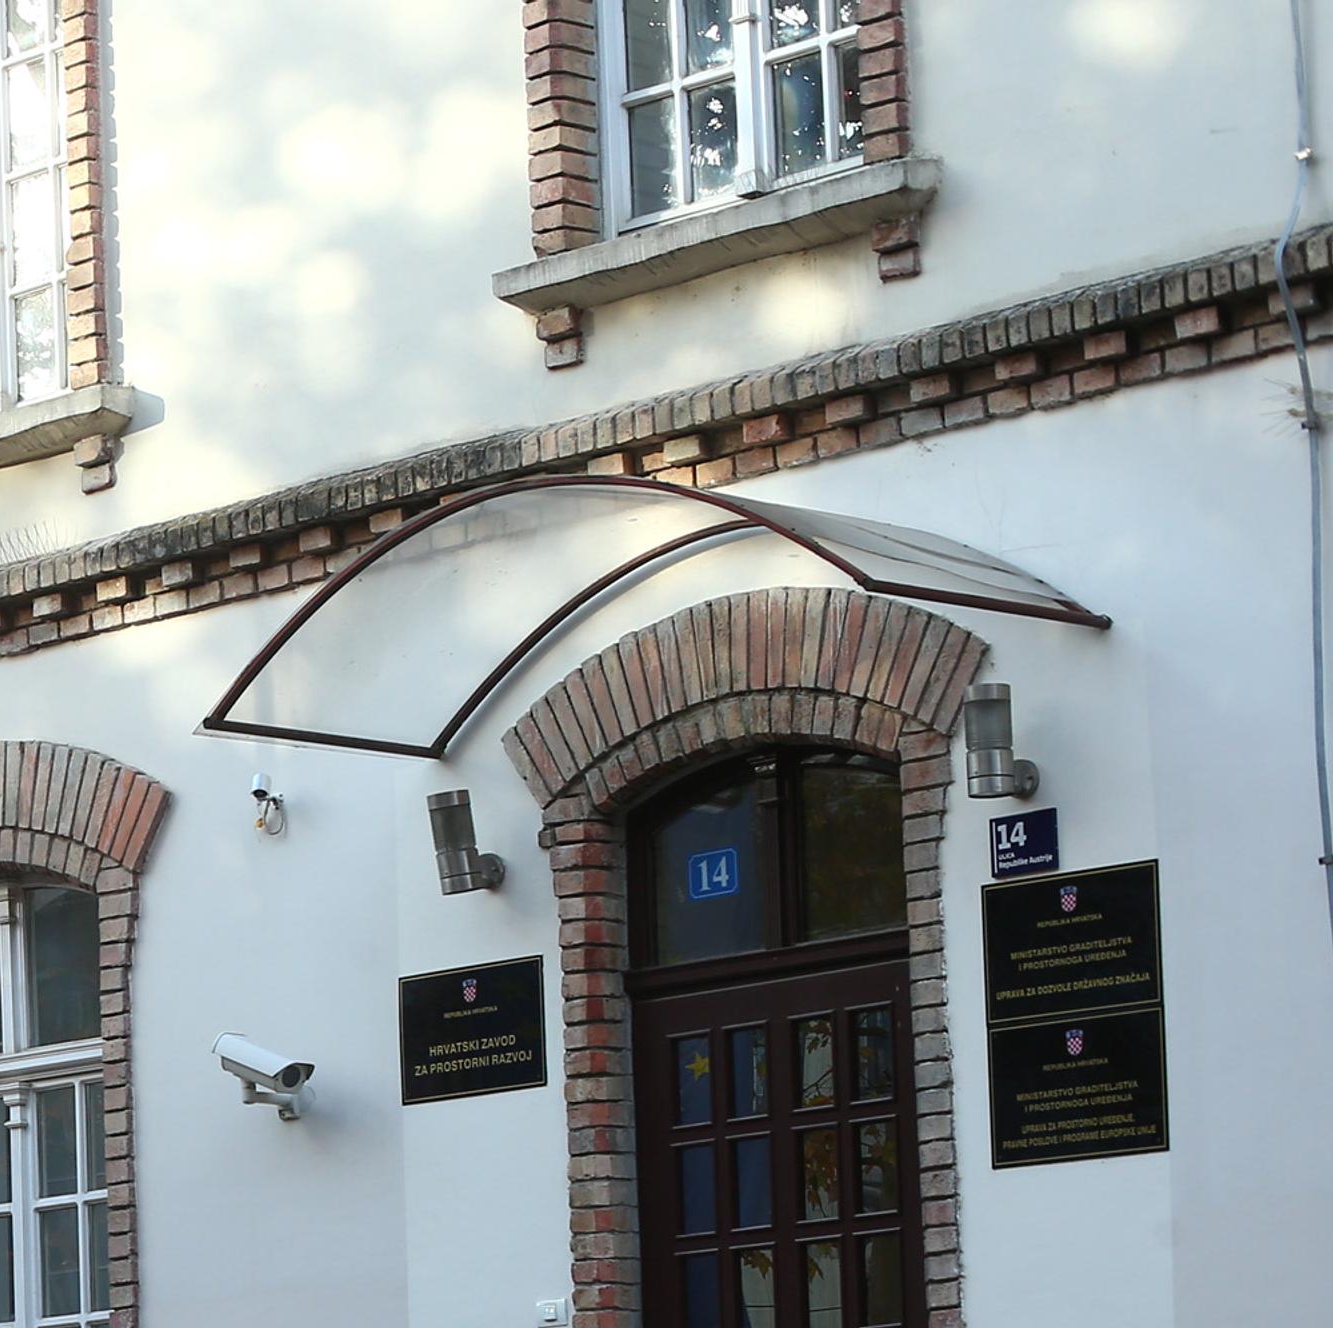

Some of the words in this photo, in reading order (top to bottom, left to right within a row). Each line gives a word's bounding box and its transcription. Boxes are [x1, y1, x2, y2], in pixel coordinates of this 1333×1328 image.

[997, 822, 1027, 850] 14
[697, 856, 729, 892] 14
[1010, 945, 1068, 960] MINISTARSTVO
[1069, 936, 1133, 952] GRADITELJSTVA
[1023, 956, 1083, 971] PROSTORNOGA
[996, 987, 1025, 1000] UPRAVA
[1026, 985, 1036, 996] ZA
[1037, 981, 1072, 995] DOZVOLE
[1073, 975, 1115, 991] DRŽAVNOG
[1116, 971, 1151, 986] ZNAČAJA
[429, 1040, 480, 1057] HRVATSKI
[481, 1034, 516, 1049] ZAVOD
[414, 1065, 428, 1076] ZA
[430, 1056, 490, 1074] PROSTORNI
[492, 1050, 533, 1065] RAZVOJ
[1016, 1088, 1074, 1102] MINISTARSTVO
[1075, 1080, 1139, 1094] GRADITELJSTVA
[1029, 1098, 1089, 1113] PROSTORNOGA
